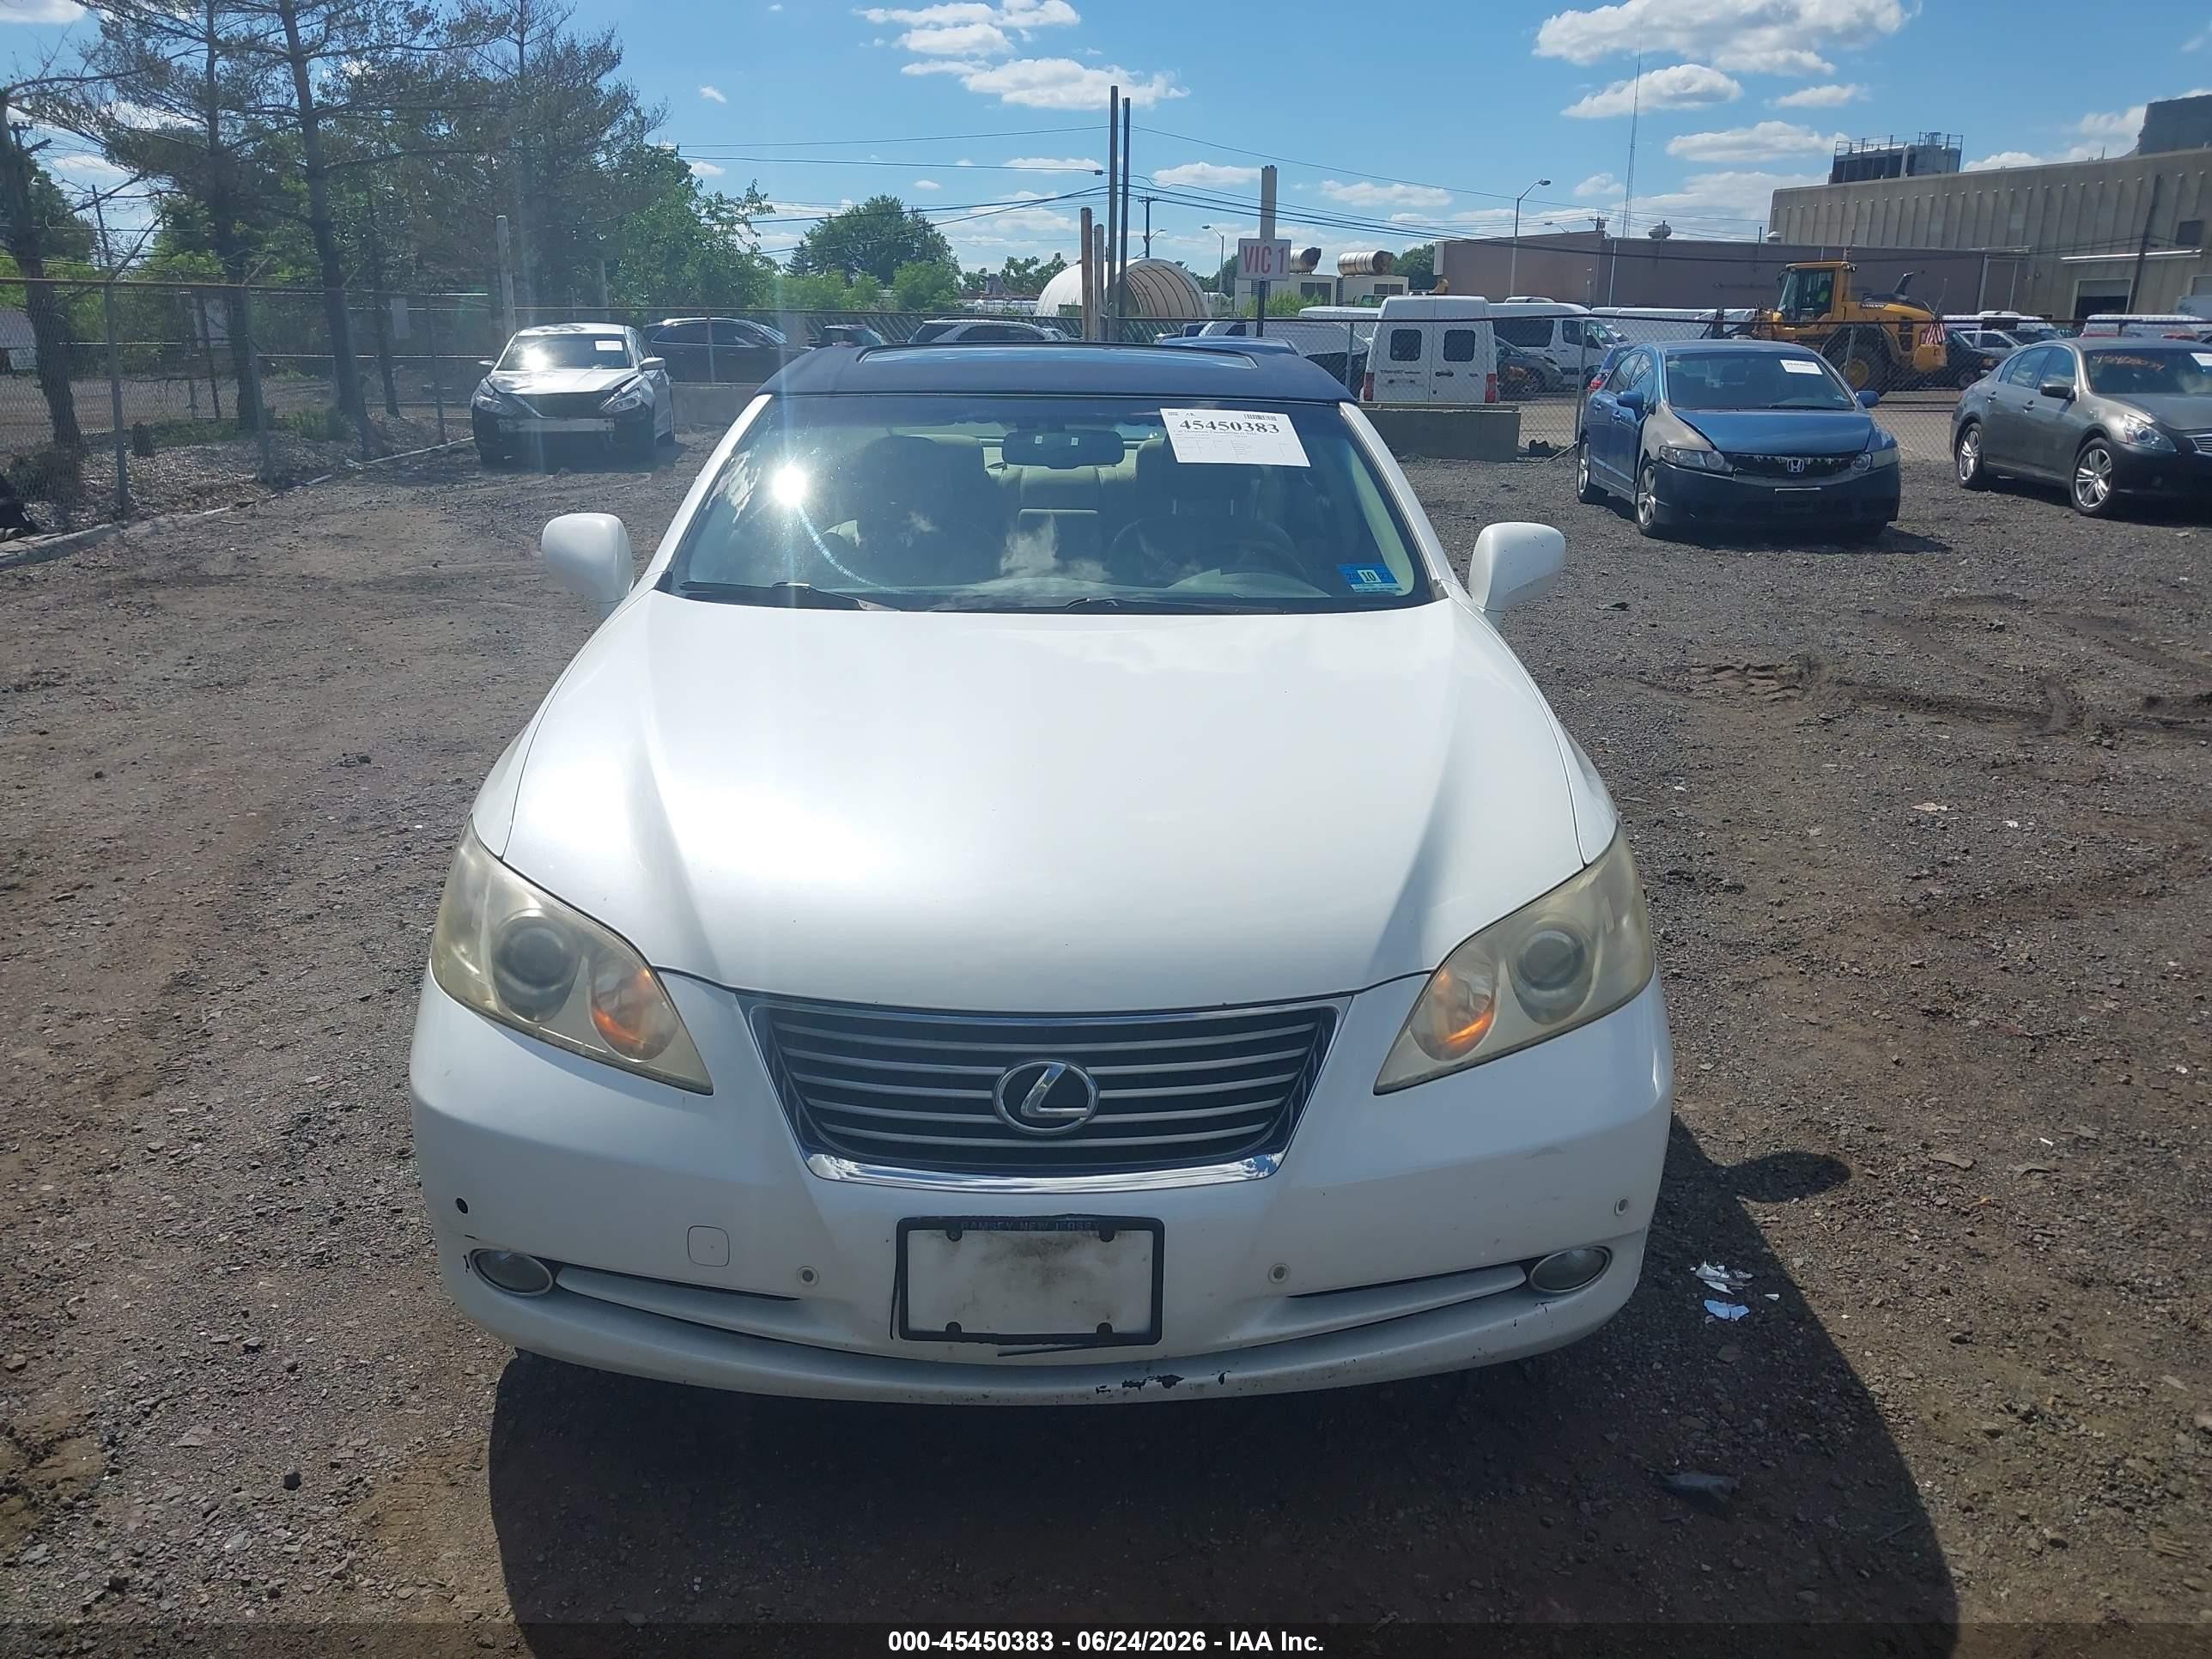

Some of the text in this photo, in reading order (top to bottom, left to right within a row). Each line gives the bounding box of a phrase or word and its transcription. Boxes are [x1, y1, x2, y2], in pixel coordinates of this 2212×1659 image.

[1243, 246, 1285, 275] VIC 1
[1180, 419, 1279, 434] 45450383
[1361, 571, 1376, 581] 10
[961, 1222, 1100, 1231] RAMSEY NEW JERSEY
